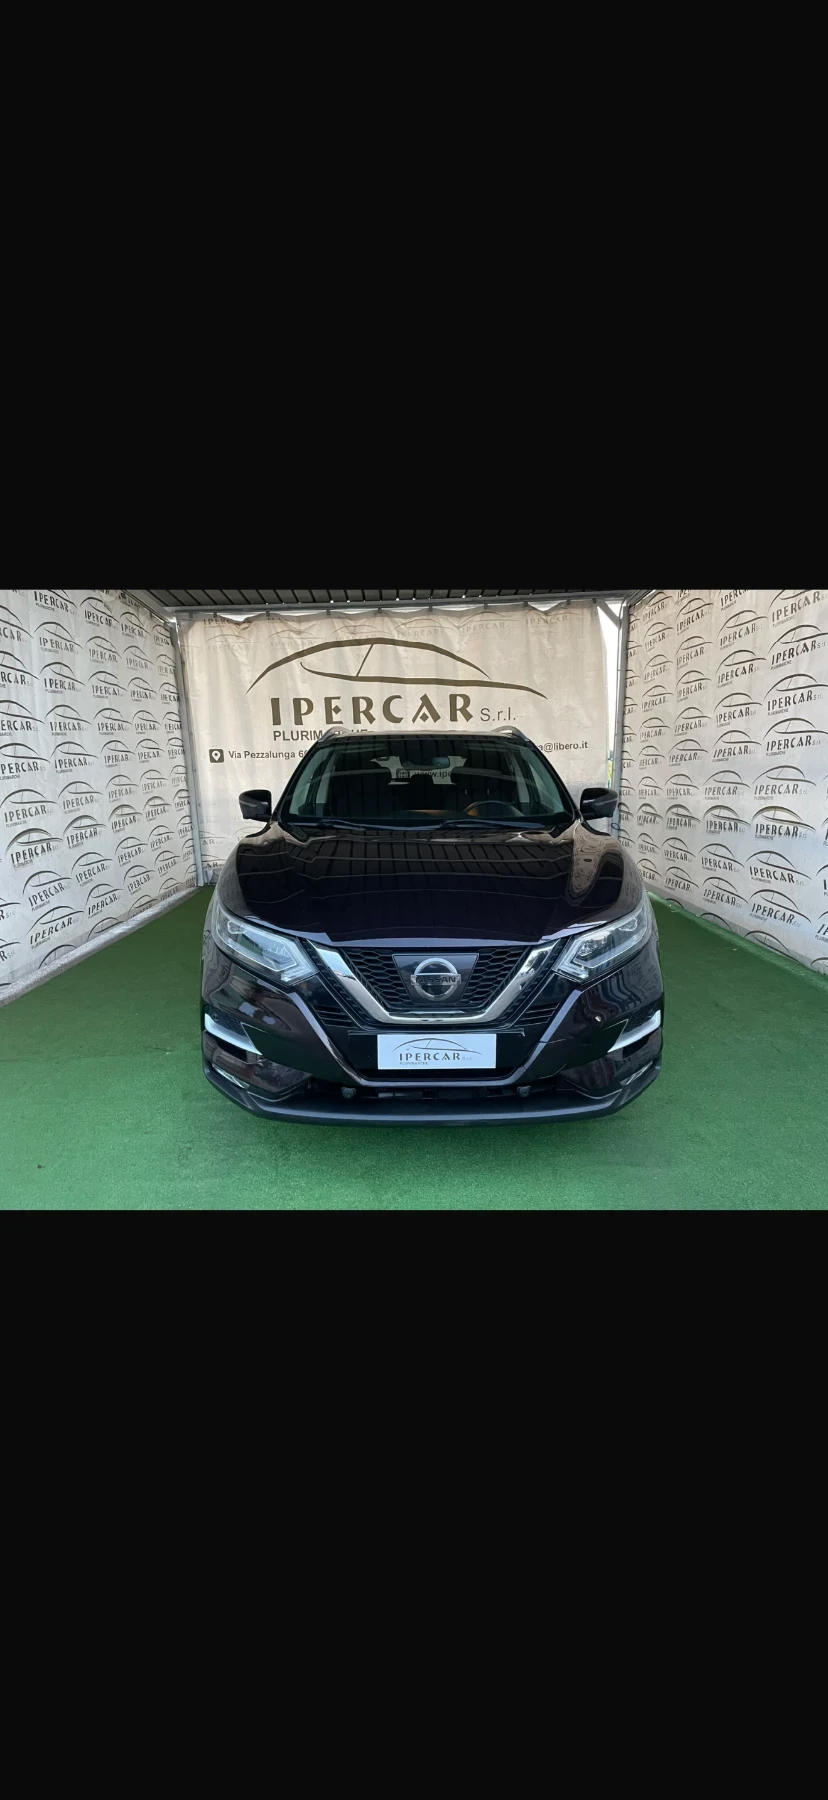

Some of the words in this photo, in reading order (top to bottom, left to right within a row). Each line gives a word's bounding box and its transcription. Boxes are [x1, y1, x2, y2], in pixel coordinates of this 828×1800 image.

[34, 591, 69, 612] IPERCAR
[772, 591, 820, 622] IPERCAR
[720, 623, 756, 646] IPERCAR
[771, 640, 817, 665] IPERCAR
[717, 663, 754, 684] IPERCAR
[44, 678, 76, 691] IPERCAR
[270, 693, 474, 725] IPERCAR
[480, 707, 516, 722] S.r.l.
[767, 690, 813, 711] IPERCAR
[716, 707, 750, 723] IPERCAR
[50, 721, 82, 731] IPERCAR
[713, 745, 749, 758] IPERCAR
[766, 735, 812, 751] IPERCAR
[55, 757, 87, 769] IPERCAR
[228, 751, 242, 759] Via
[244, 750, 296, 760] Pezzalunga
[705, 786, 738, 795] IPERCAR
[754, 784, 799, 795] IPERCAR
[63, 795, 94, 809] IPERCAR
[4, 804, 47, 822] IPERCAR
[67, 828, 97, 845] IPERCAR
[755, 824, 799, 837] IPERCAR
[11, 842, 52, 864] IPERCAR
[702, 857, 733, 871] IPERCAR
[76, 863, 106, 883] IPERCAR
[749, 866, 795, 883] IPERCAR
[28, 882, 64, 907] IPERCAR
[703, 888, 736, 906] IPERCAR
[88, 894, 118, 915] IPERCAR
[751, 903, 795, 925] IPERCAR
[30, 917, 72, 945] IPERCAR
[399, 1052, 461, 1061] IPERCAR
